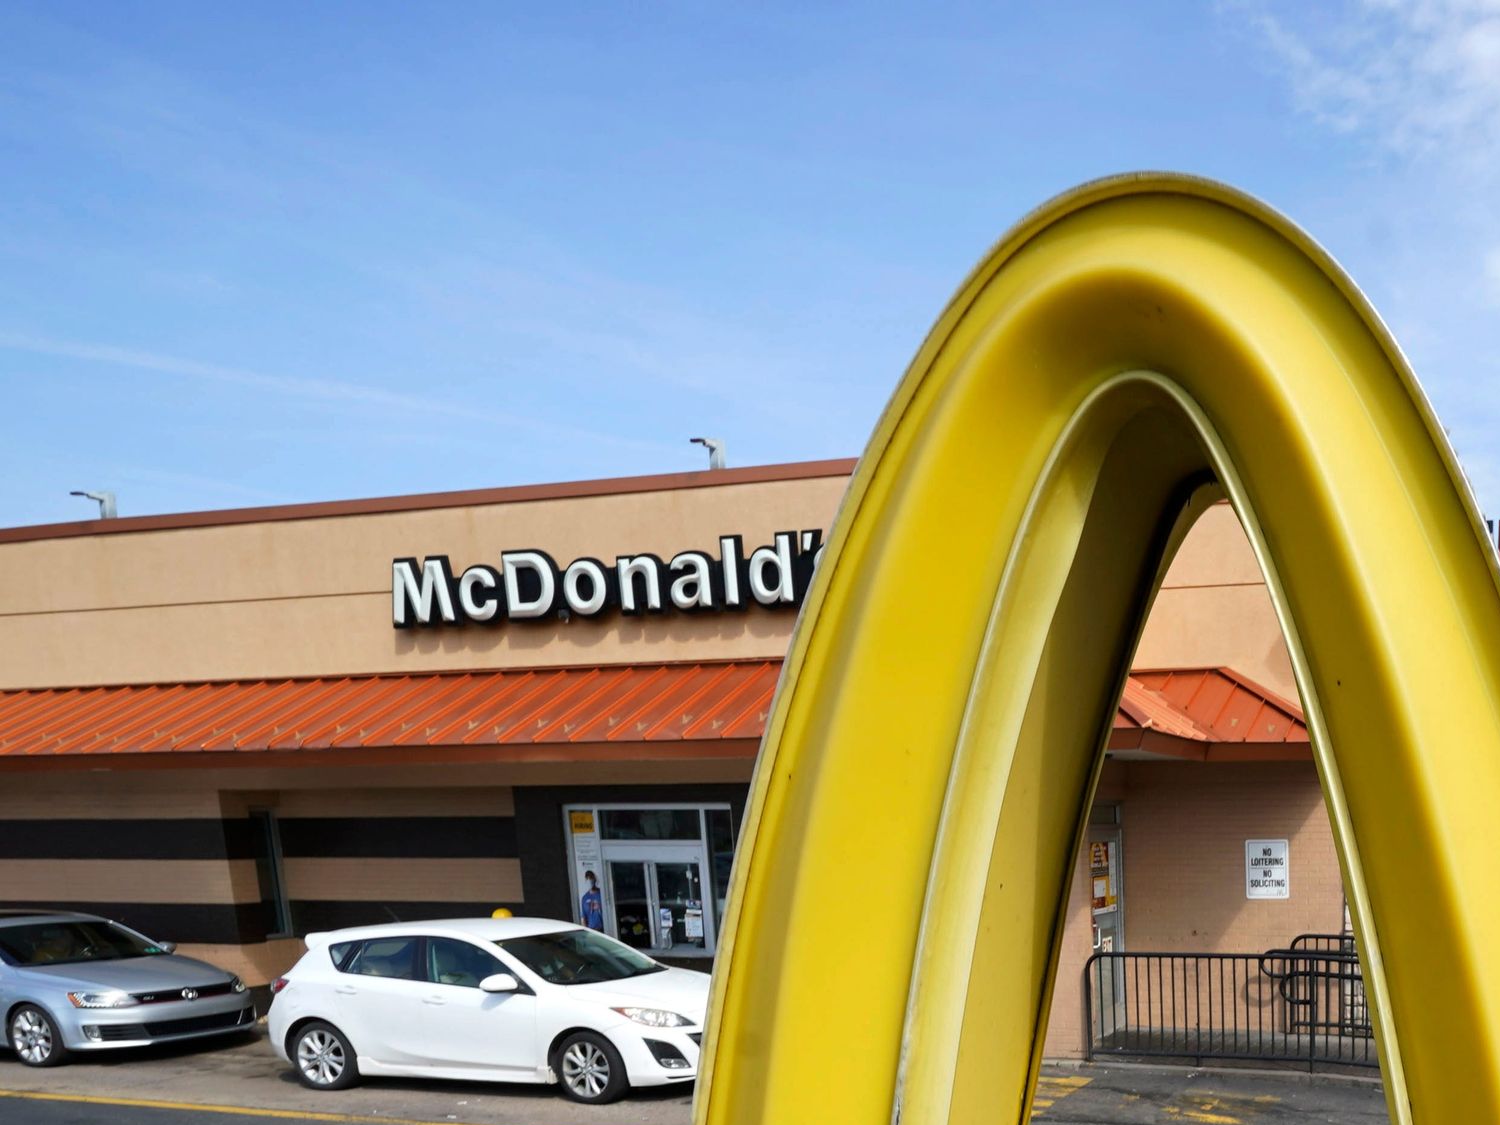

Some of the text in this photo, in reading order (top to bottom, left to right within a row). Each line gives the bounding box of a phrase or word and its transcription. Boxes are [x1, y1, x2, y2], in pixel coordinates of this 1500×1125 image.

[392, 529, 826, 628] McDonald'
[1262, 847, 1272, 857] NO
[1250, 857, 1284, 867] LOITERING
[1262, 869, 1272, 878] NO
[1250, 879, 1285, 888] SOLICITING
